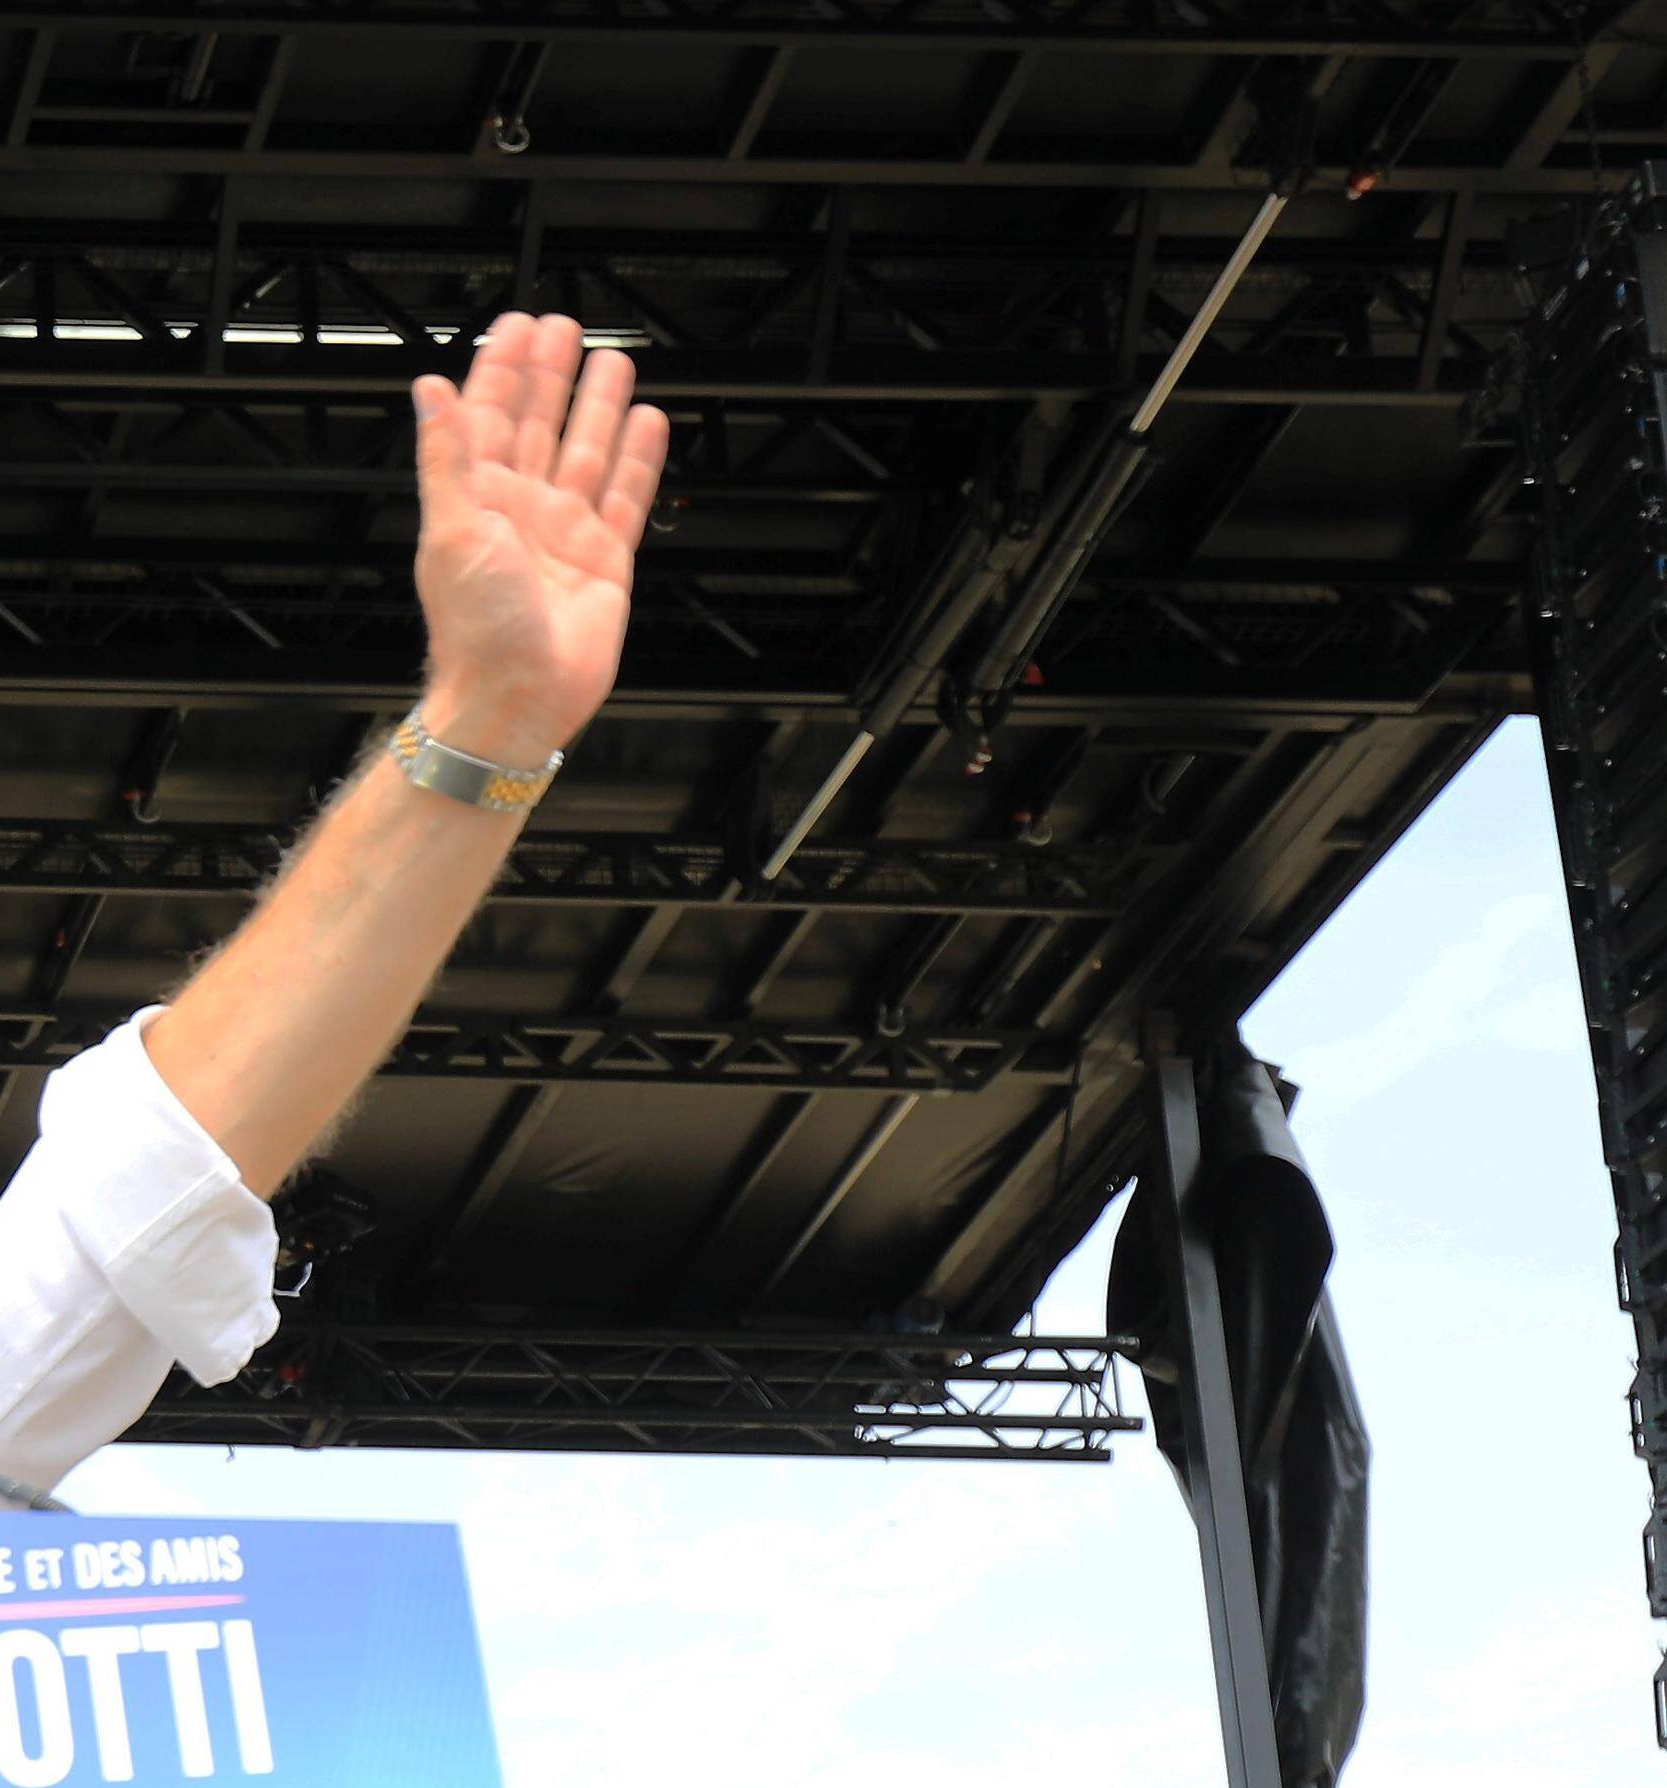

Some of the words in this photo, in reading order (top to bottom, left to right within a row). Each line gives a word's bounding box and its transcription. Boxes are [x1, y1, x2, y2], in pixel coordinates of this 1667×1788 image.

[26, 1548, 63, 1590] ET
[74, 1541, 145, 1589] DES
[151, 1536, 243, 1584] AMIS
